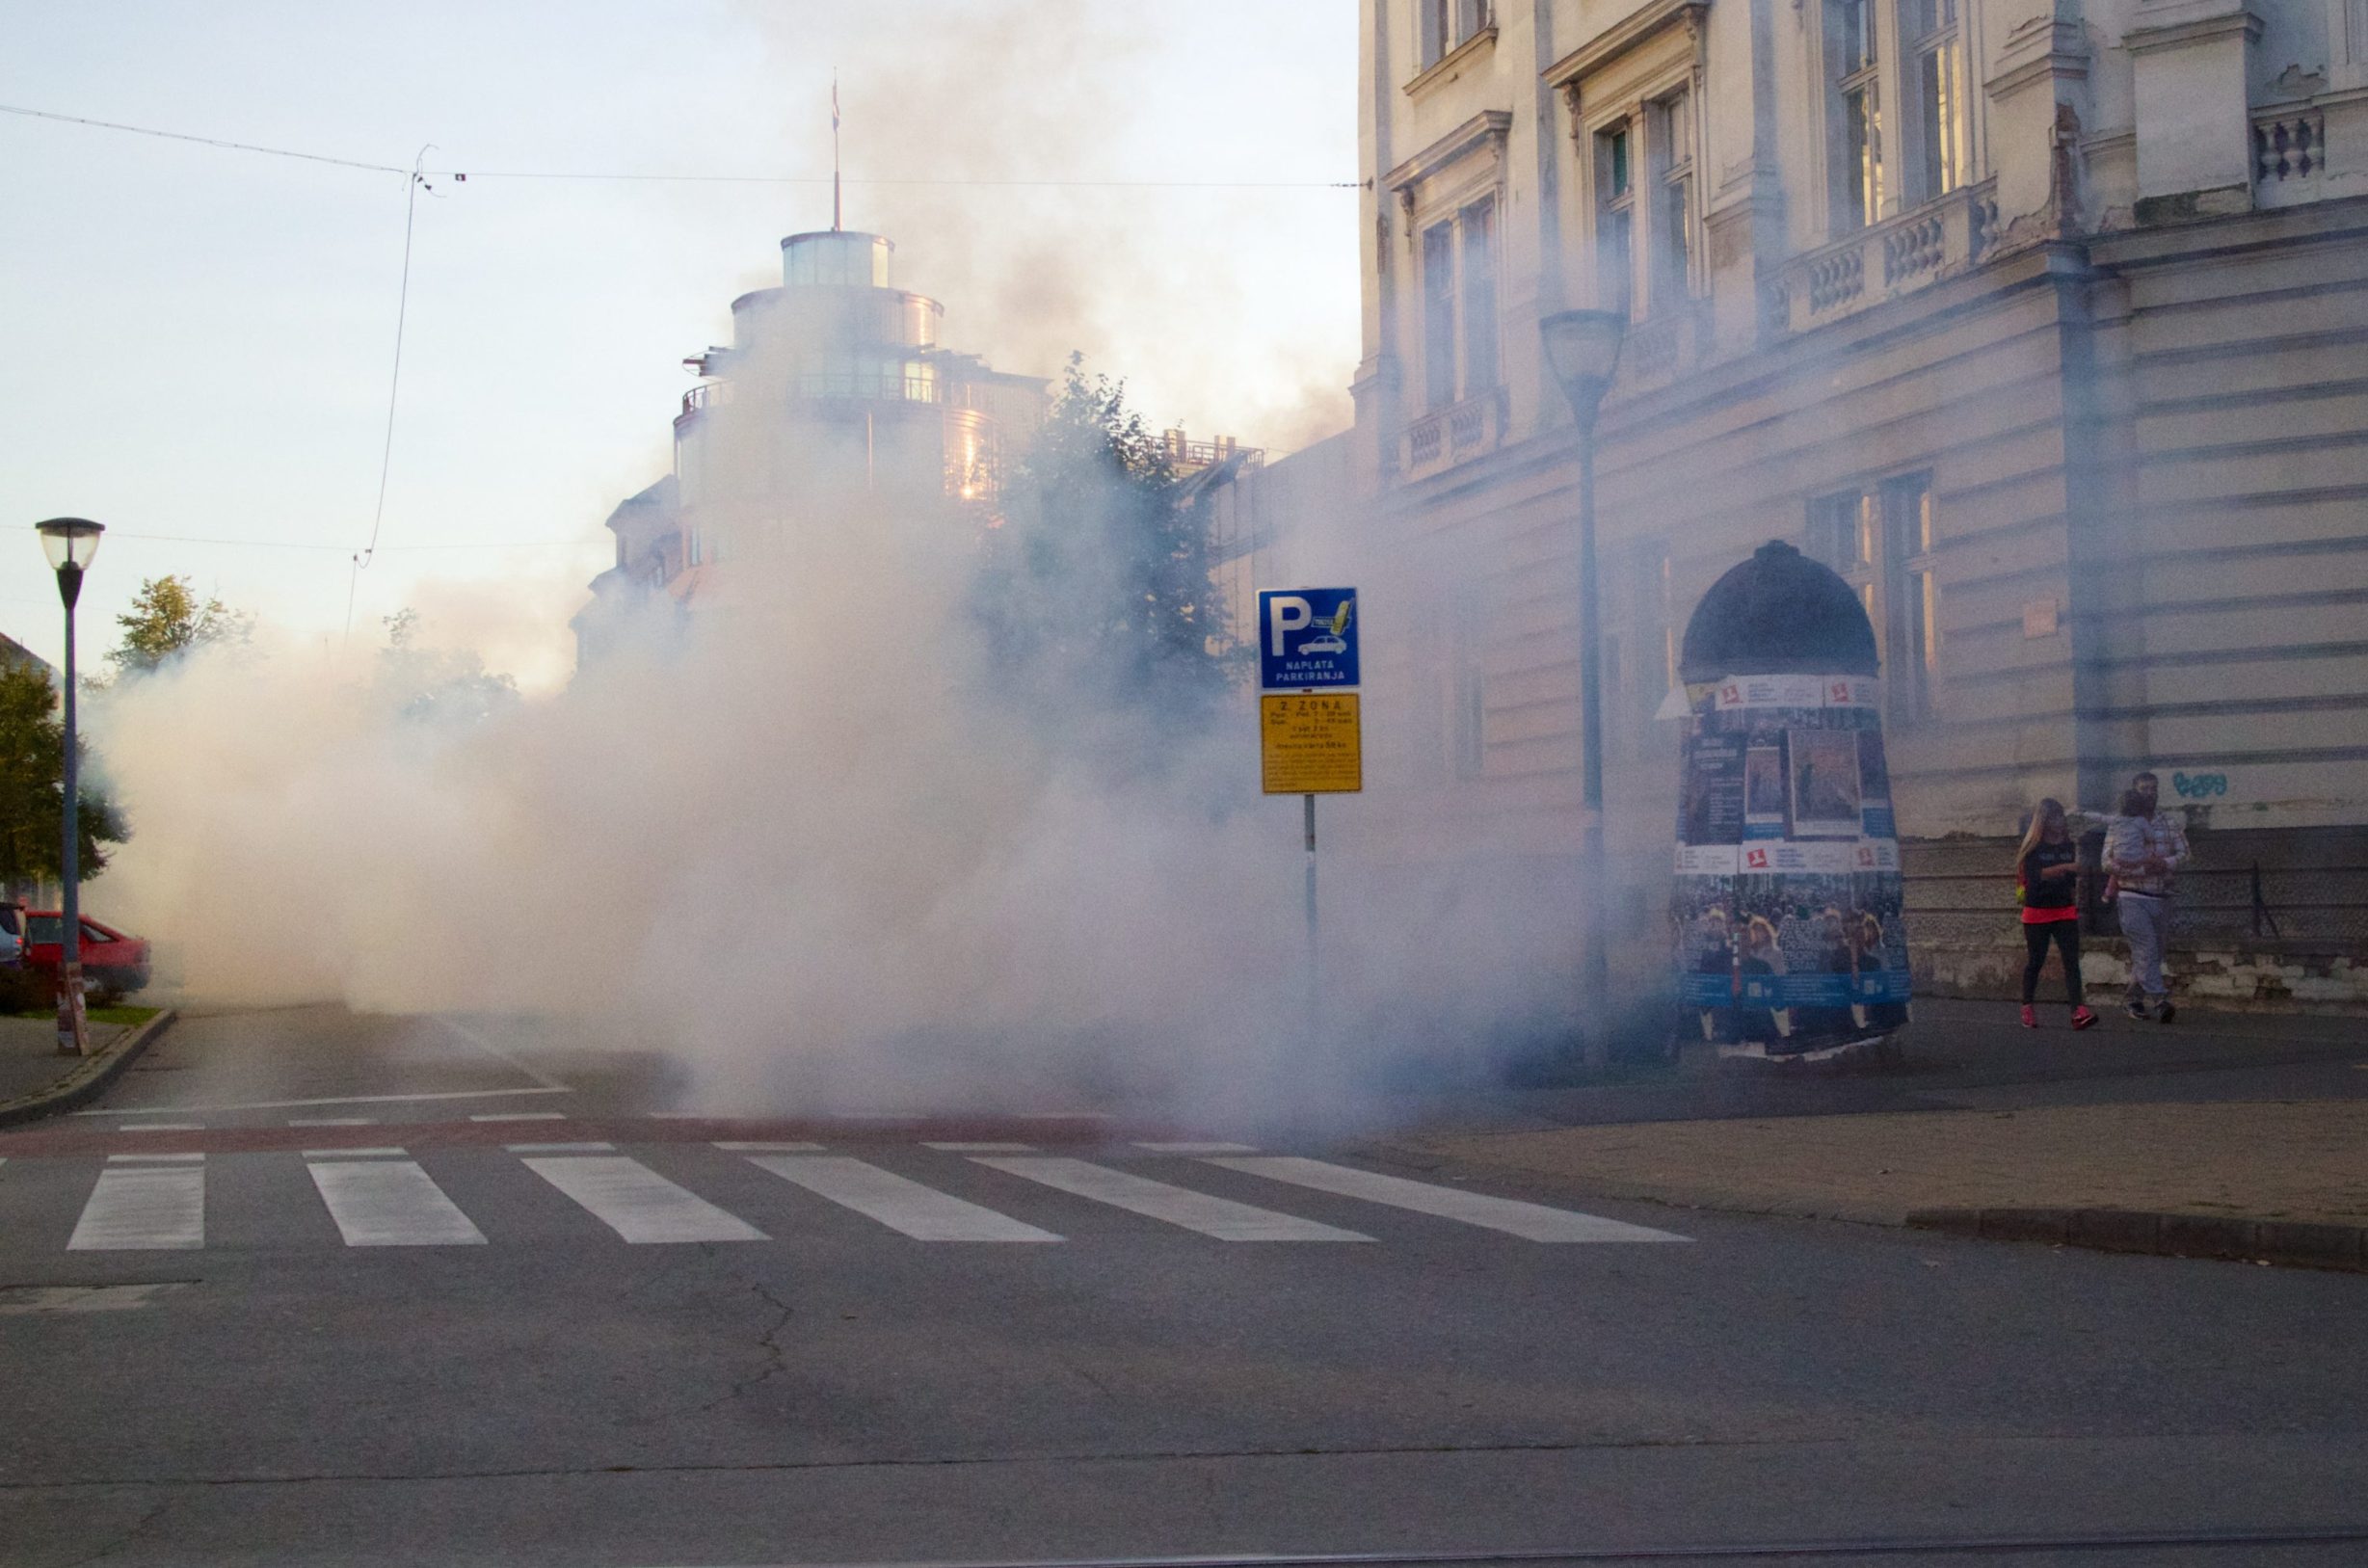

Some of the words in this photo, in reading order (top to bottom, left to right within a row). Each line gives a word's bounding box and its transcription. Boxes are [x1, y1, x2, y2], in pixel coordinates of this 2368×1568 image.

[1269, 596, 1312, 656] P
[1285, 659, 1334, 670] NAPLATA
[1275, 671, 1345, 681] PARKIRANJA
[1299, 700, 1341, 710] ZONA
